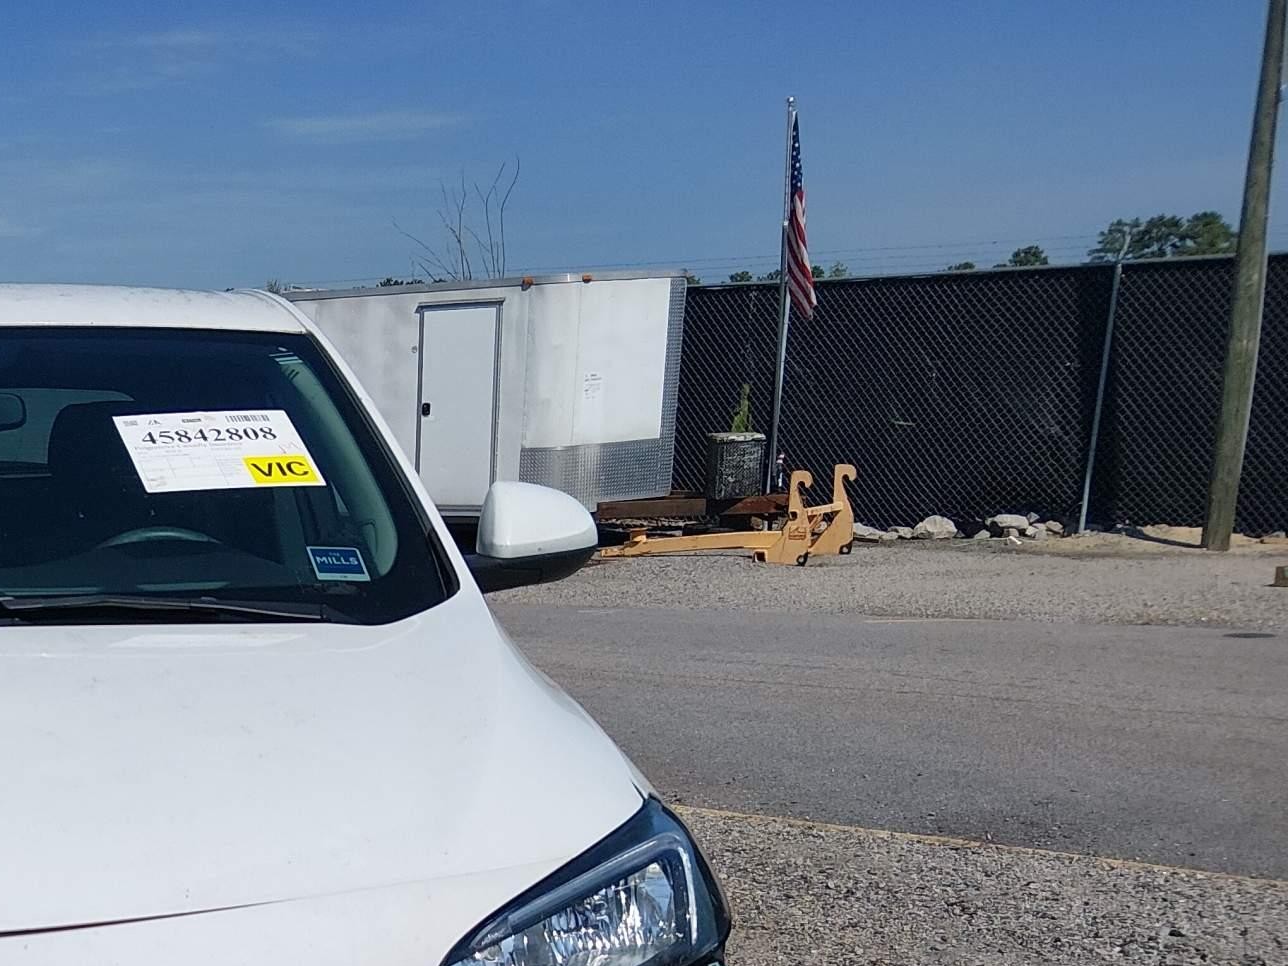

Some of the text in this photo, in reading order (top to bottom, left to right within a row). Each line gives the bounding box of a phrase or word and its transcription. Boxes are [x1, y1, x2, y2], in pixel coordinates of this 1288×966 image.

[142, 426, 277, 444] 45842808
[251, 461, 310, 477] VIC
[315, 556, 359, 566] MILLS
